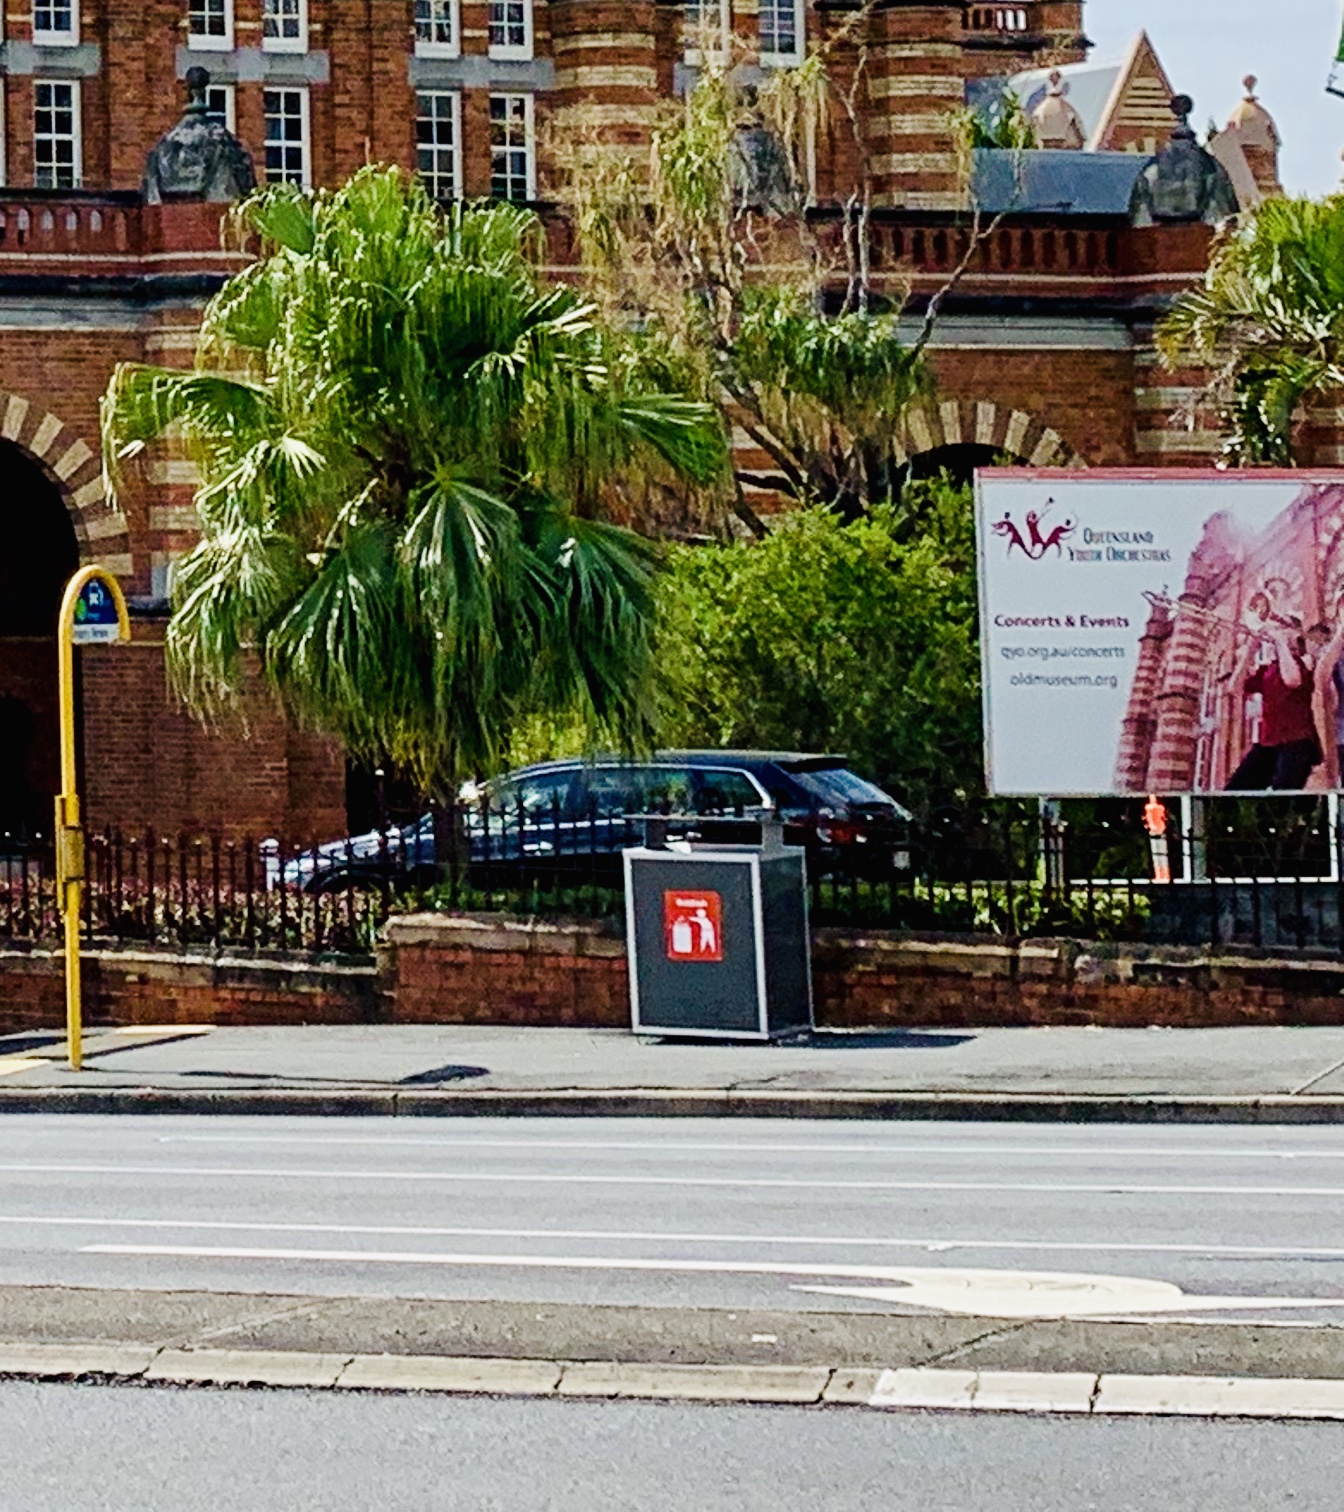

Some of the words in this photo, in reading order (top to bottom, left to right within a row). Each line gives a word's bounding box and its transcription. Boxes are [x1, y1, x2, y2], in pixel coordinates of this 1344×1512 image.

[994, 614, 1061, 628] Concerts
[1064, 614, 1075, 628] &
[1079, 614, 1129, 628] Events
[1009, 672, 1118, 688] oldmuseum.org
